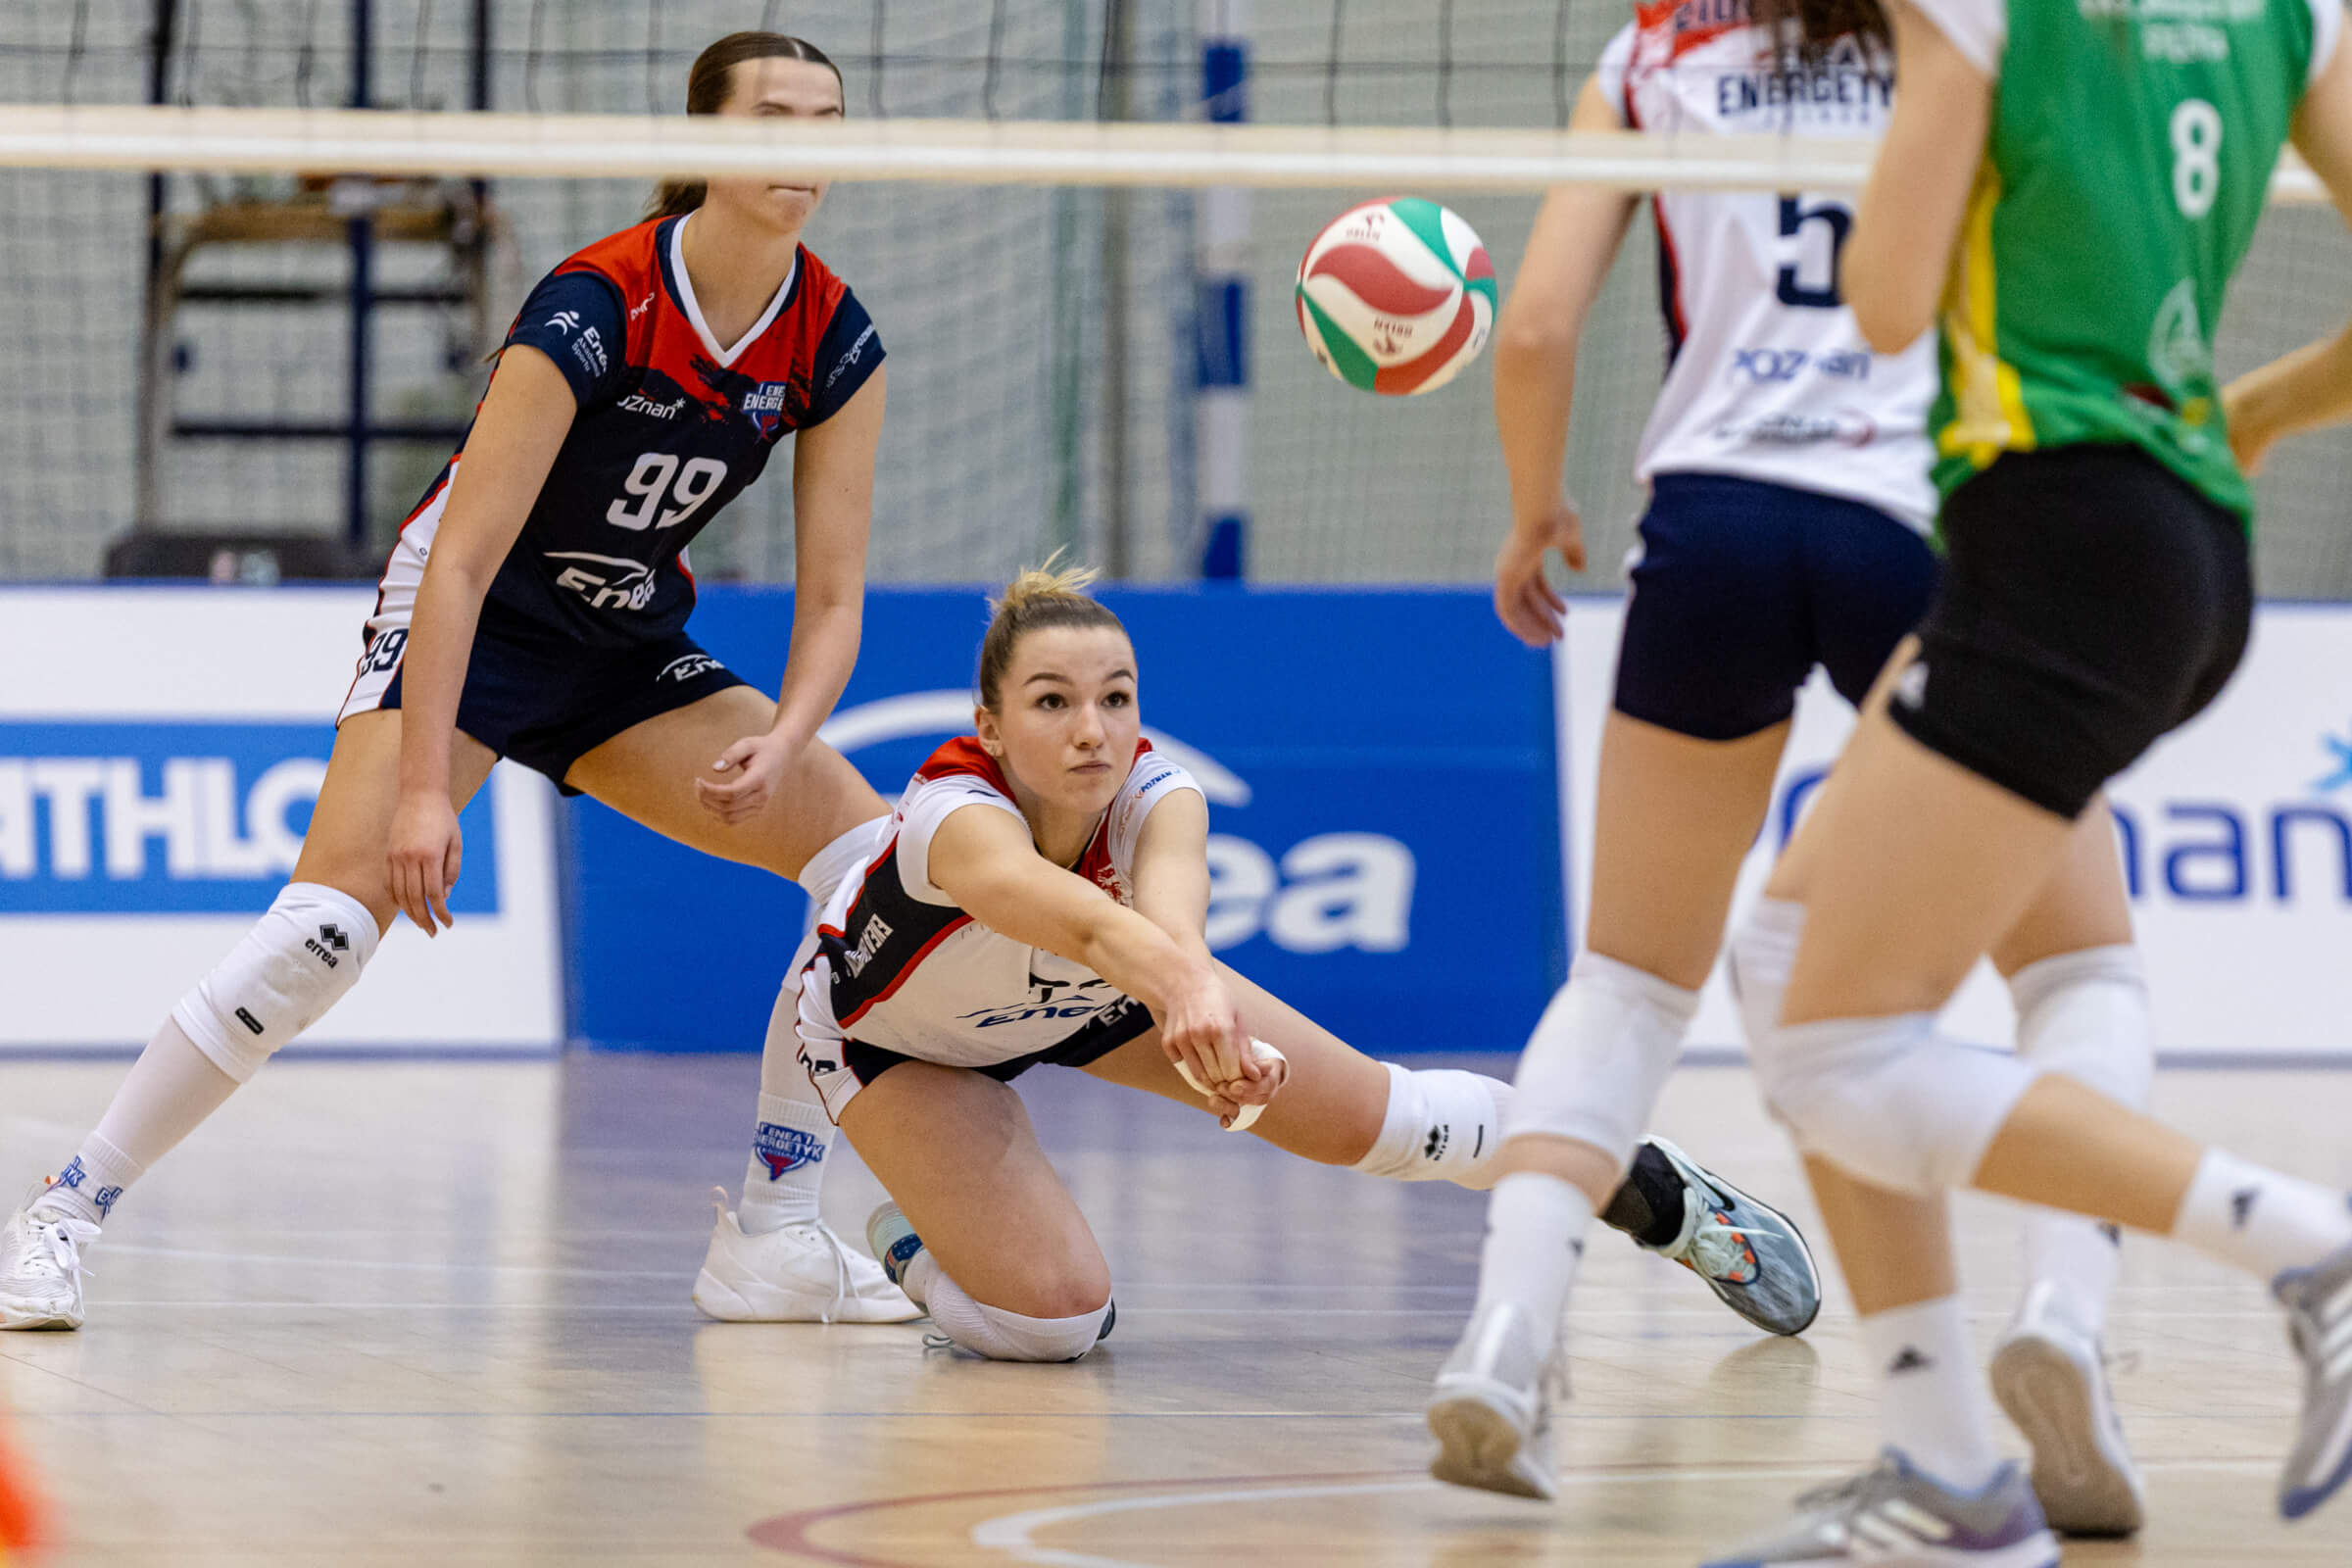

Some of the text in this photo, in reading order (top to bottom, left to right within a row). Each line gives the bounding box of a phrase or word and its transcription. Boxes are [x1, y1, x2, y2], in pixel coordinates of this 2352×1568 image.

[2170, 98, 2224, 219] 8
[606, 452, 728, 531] 99
[305, 938, 339, 969] errea
